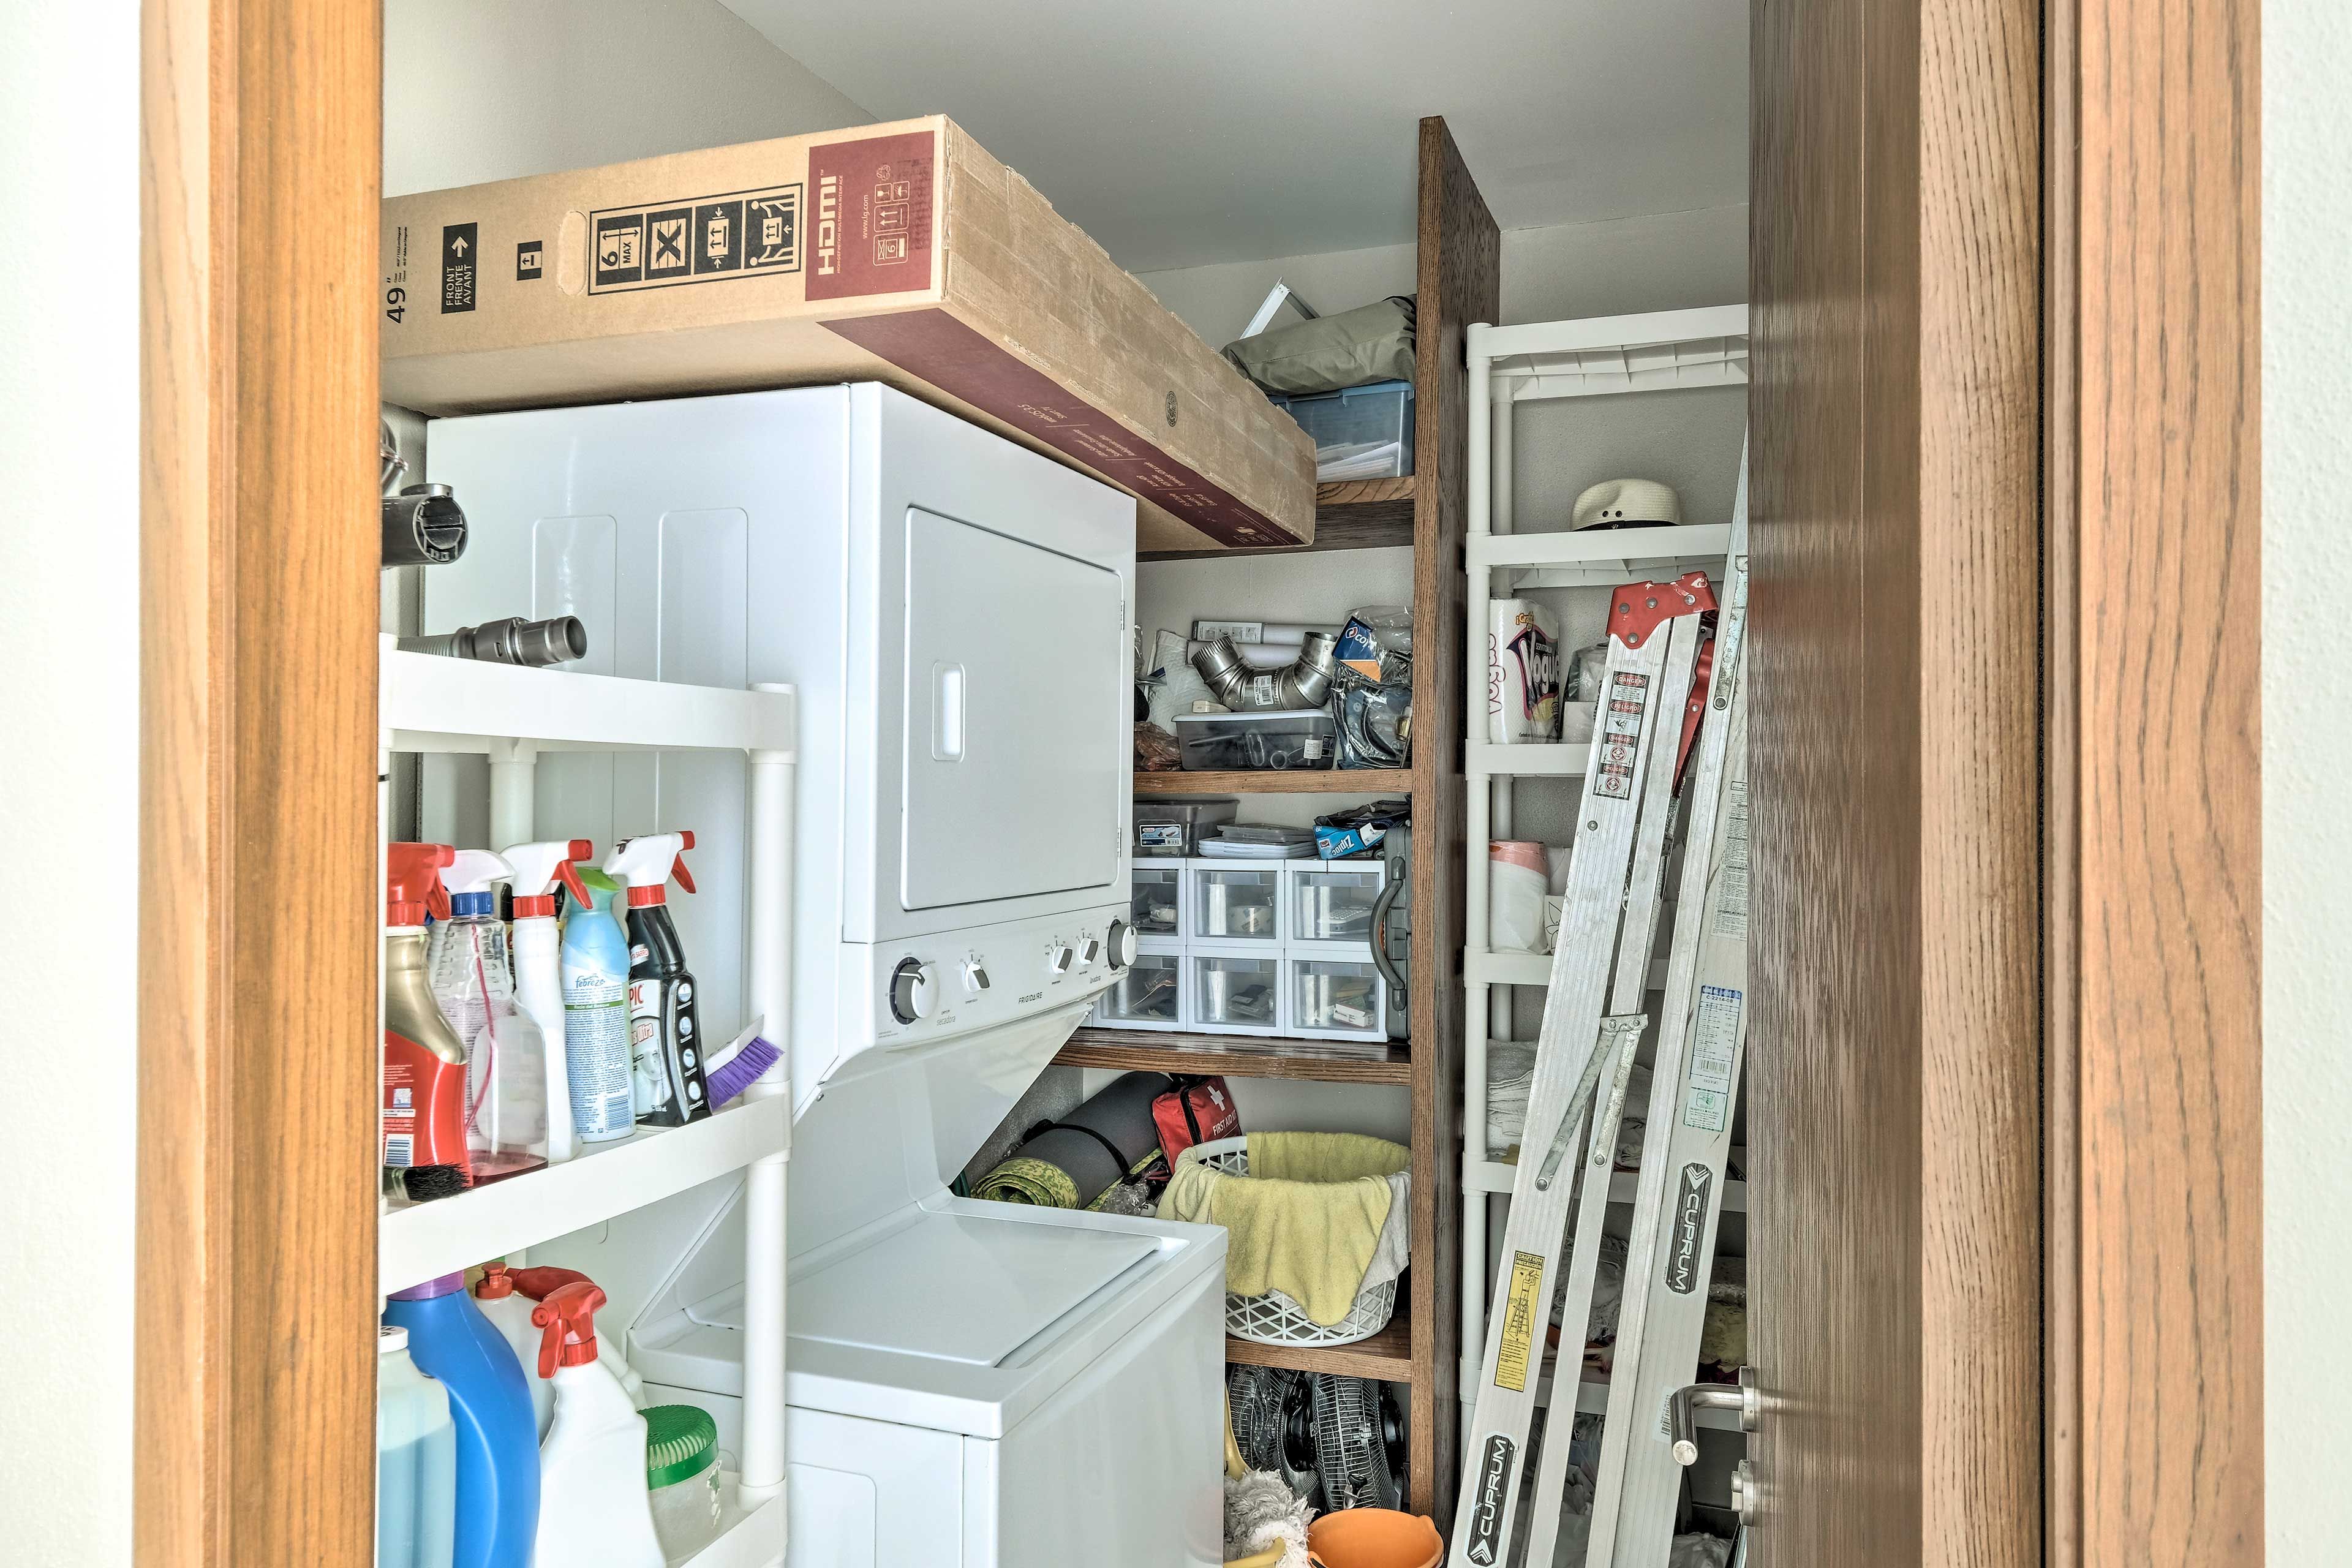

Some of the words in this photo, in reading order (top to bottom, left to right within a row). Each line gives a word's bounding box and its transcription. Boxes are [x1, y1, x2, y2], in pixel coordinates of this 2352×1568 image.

[818, 176, 837, 275] HDMI
[601, 251, 618, 266] 6
[623, 241, 631, 263] MAX
[887, 244, 895, 253] 6
[446, 266, 455, 306] FRONT
[454, 265, 463, 305] FRENTE
[463, 264, 472, 304] AVANT
[1332, 834, 1355, 856] Ziploc
[575, 975, 605, 988] febreze
[629, 984, 644, 1006] PIC
[1018, 992, 1042, 1004] FRIGIDAIRE
[1706, 995, 1733, 1003] C-2214-08
[1212, 1119, 1226, 1136] FIRST
[1674, 1193, 1700, 1291] CUPRUM
[1517, 1254, 1543, 1262] CAUTION
[1480, 1439, 1507, 1536] CUPRUM
